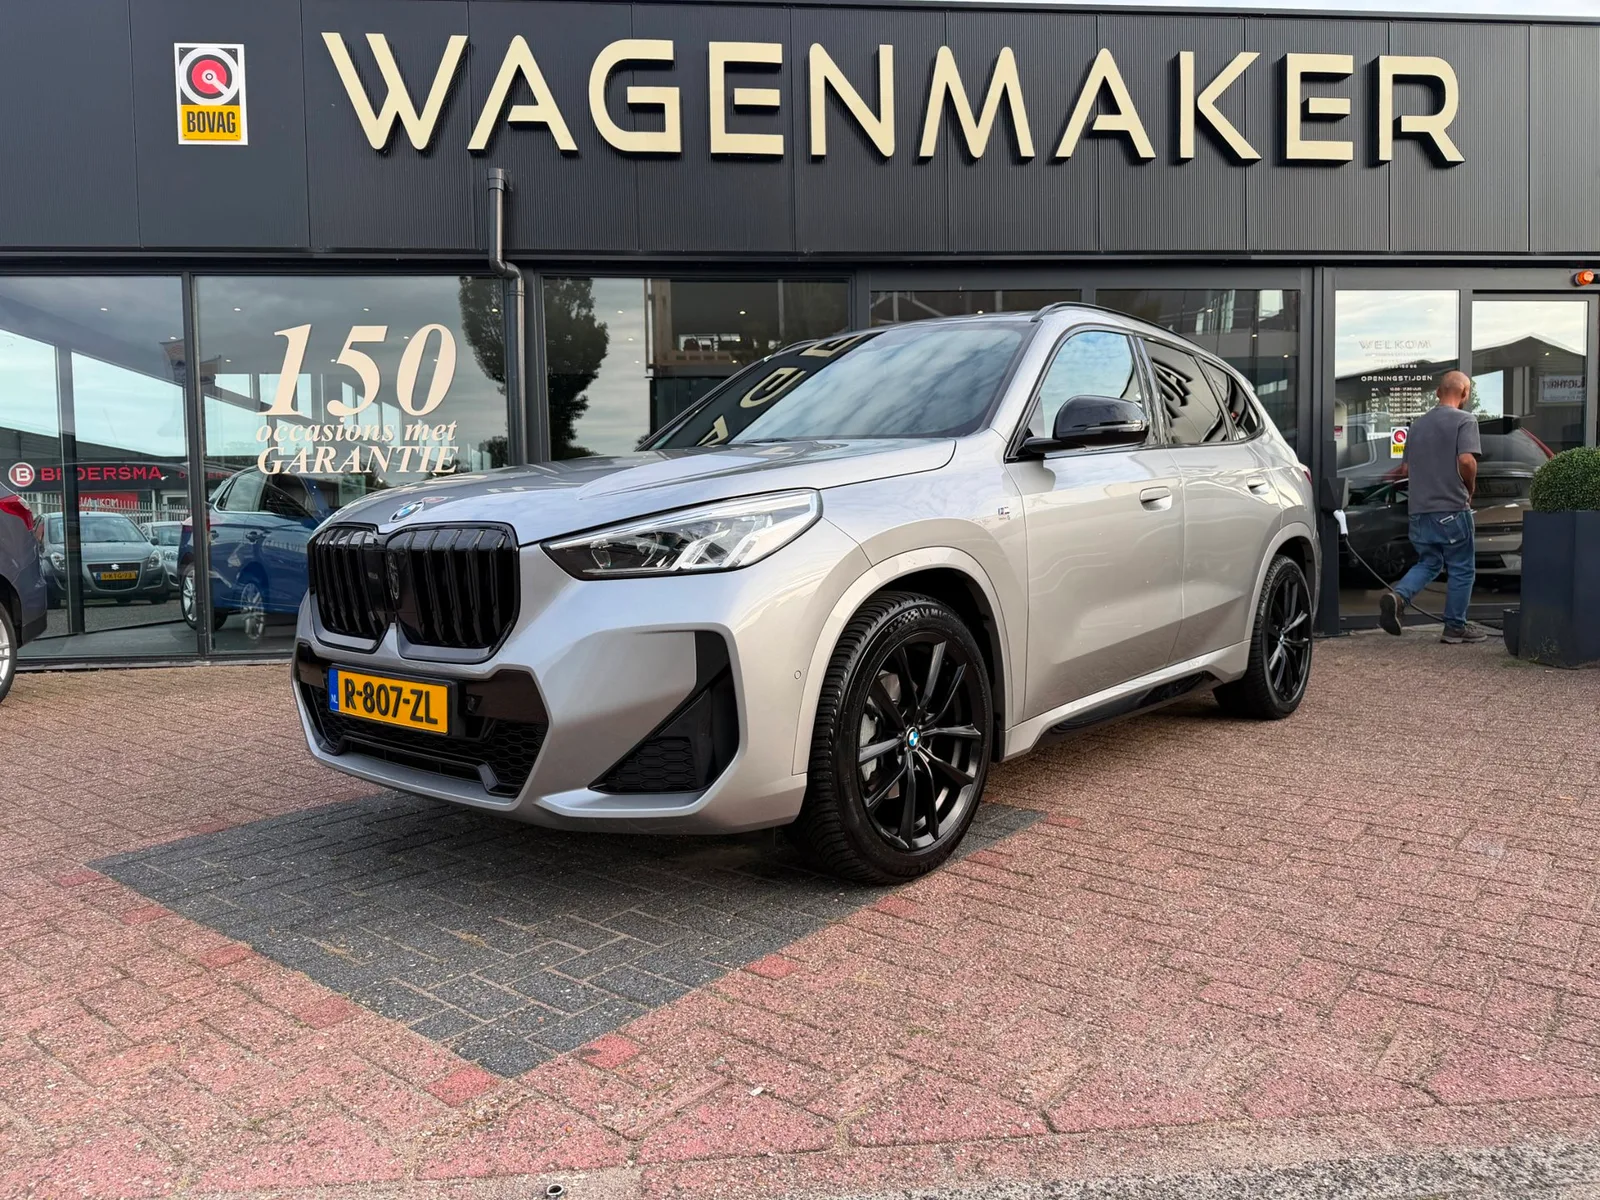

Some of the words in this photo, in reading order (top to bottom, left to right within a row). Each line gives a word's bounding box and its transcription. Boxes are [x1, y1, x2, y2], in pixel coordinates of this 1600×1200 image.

[321, 32, 1465, 163] WAGENMAKER
[186, 109, 237, 135] BOVAG
[257, 323, 458, 418] 150
[256, 416, 396, 443] occasions
[404, 419, 458, 442] met
[257, 445, 460, 475] GARANTIE
[344, 678, 438, 725] R-807-ZL
